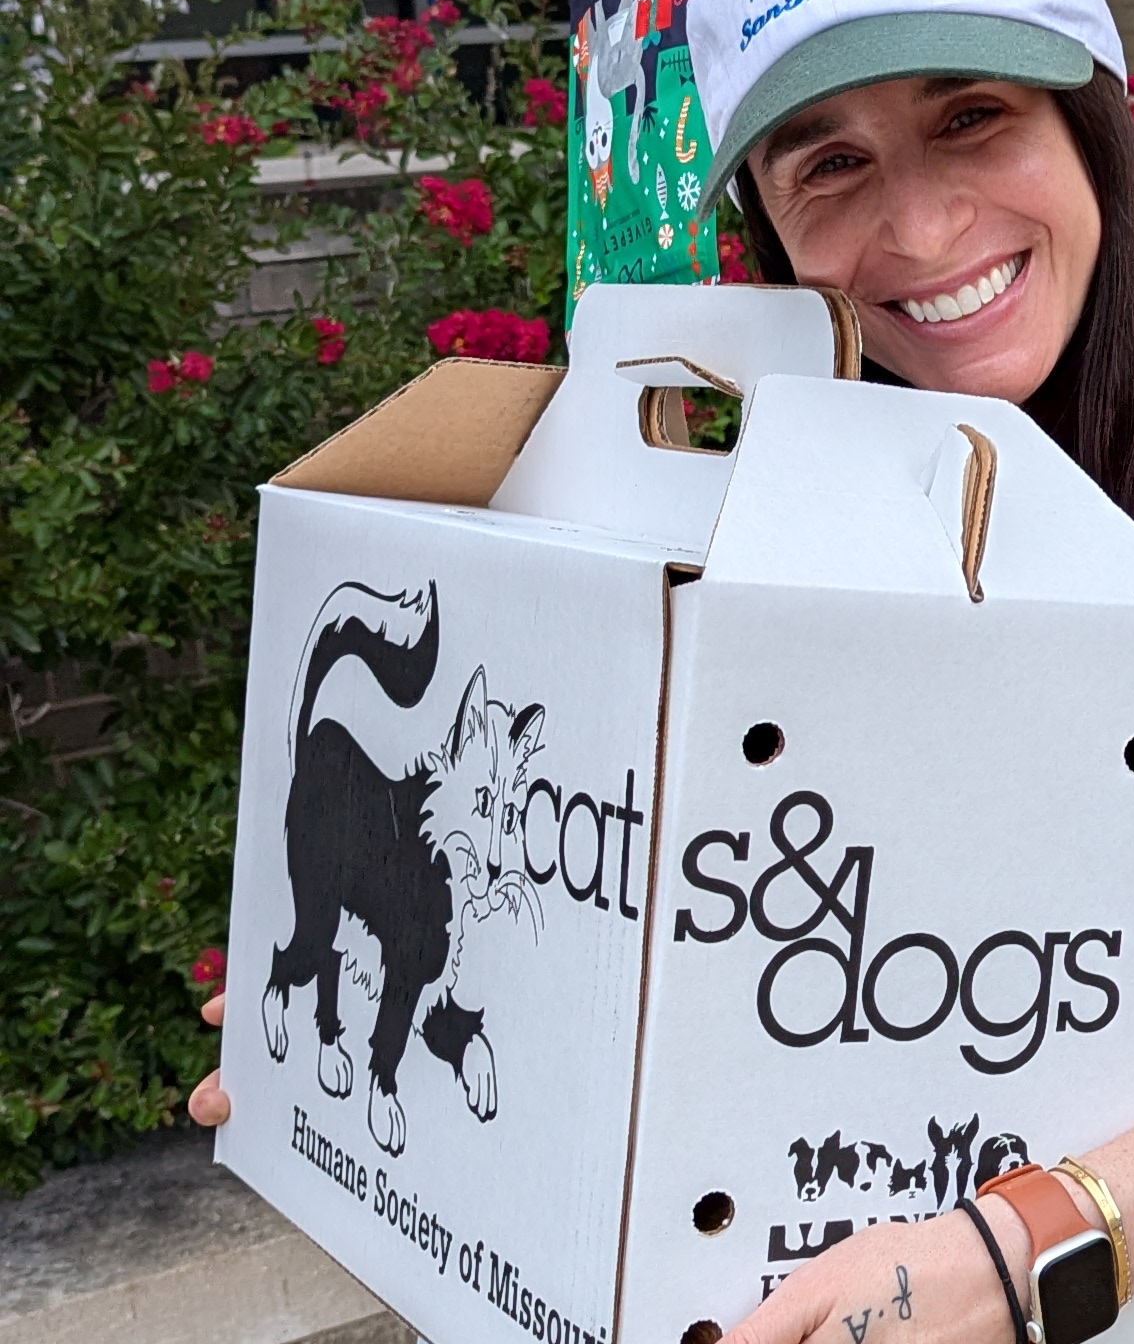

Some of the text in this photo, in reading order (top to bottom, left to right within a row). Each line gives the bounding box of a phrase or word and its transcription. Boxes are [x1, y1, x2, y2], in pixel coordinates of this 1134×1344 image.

[740, 2, 785, 52] San
[604, 217, 652, 255] GIVEPET
[756, 846, 1122, 1075] dogs
[291, 1105, 367, 1202] Humane
[374, 1168, 453, 1276] Society
[459, 1240, 484, 1293] of
